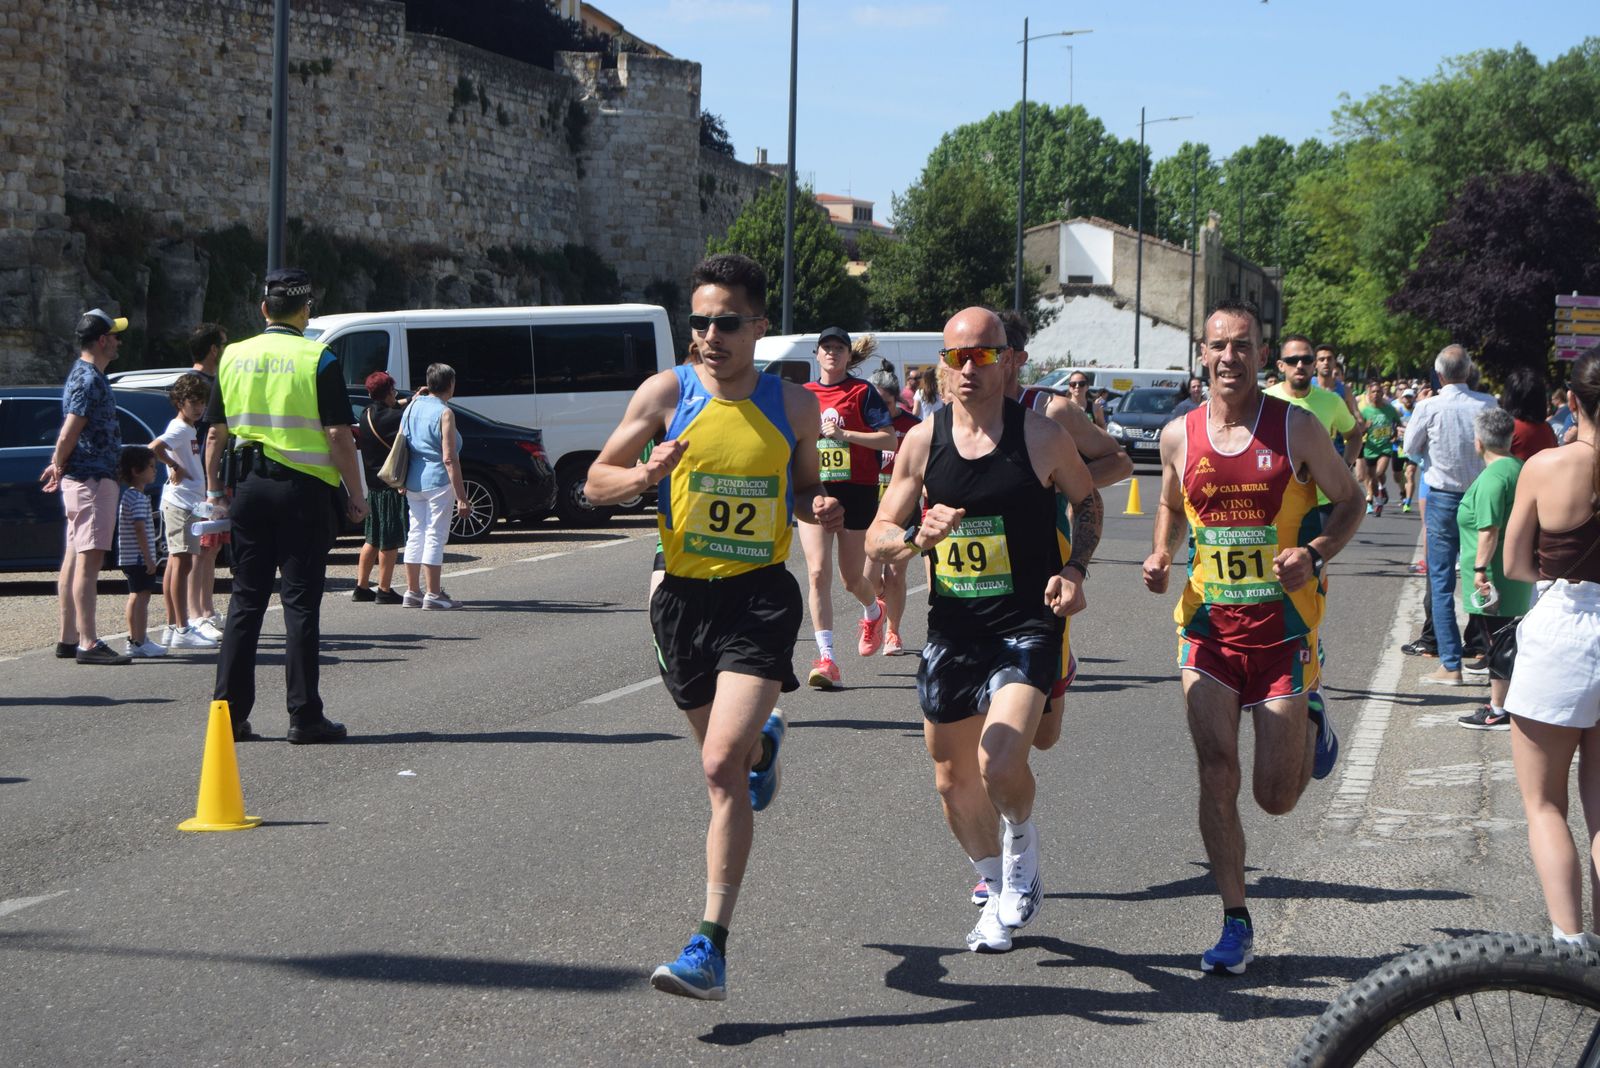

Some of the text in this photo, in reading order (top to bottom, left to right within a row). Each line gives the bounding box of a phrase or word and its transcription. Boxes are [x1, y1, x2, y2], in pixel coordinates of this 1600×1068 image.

[235, 354, 295, 374] POLICÍA
[717, 478, 769, 489] FUNDACION
[1220, 483, 1269, 493] CAJA RURAL
[716, 486, 768, 496] CAJA RURAL
[1221, 499, 1253, 509] VINO
[709, 500, 756, 536] 92
[1211, 510, 1266, 521] DE TORO
[966, 528, 993, 536] RURAL
[1218, 529, 1266, 538] FUNDACION
[1239, 537, 1266, 545] RURAL
[709, 542, 770, 557] CAJA RURAL
[947, 541, 987, 572] 49
[1211, 549, 1264, 580] 151
[953, 580, 1008, 591] CAJA RURAL
[1224, 587, 1278, 599] CAJA RURAL
